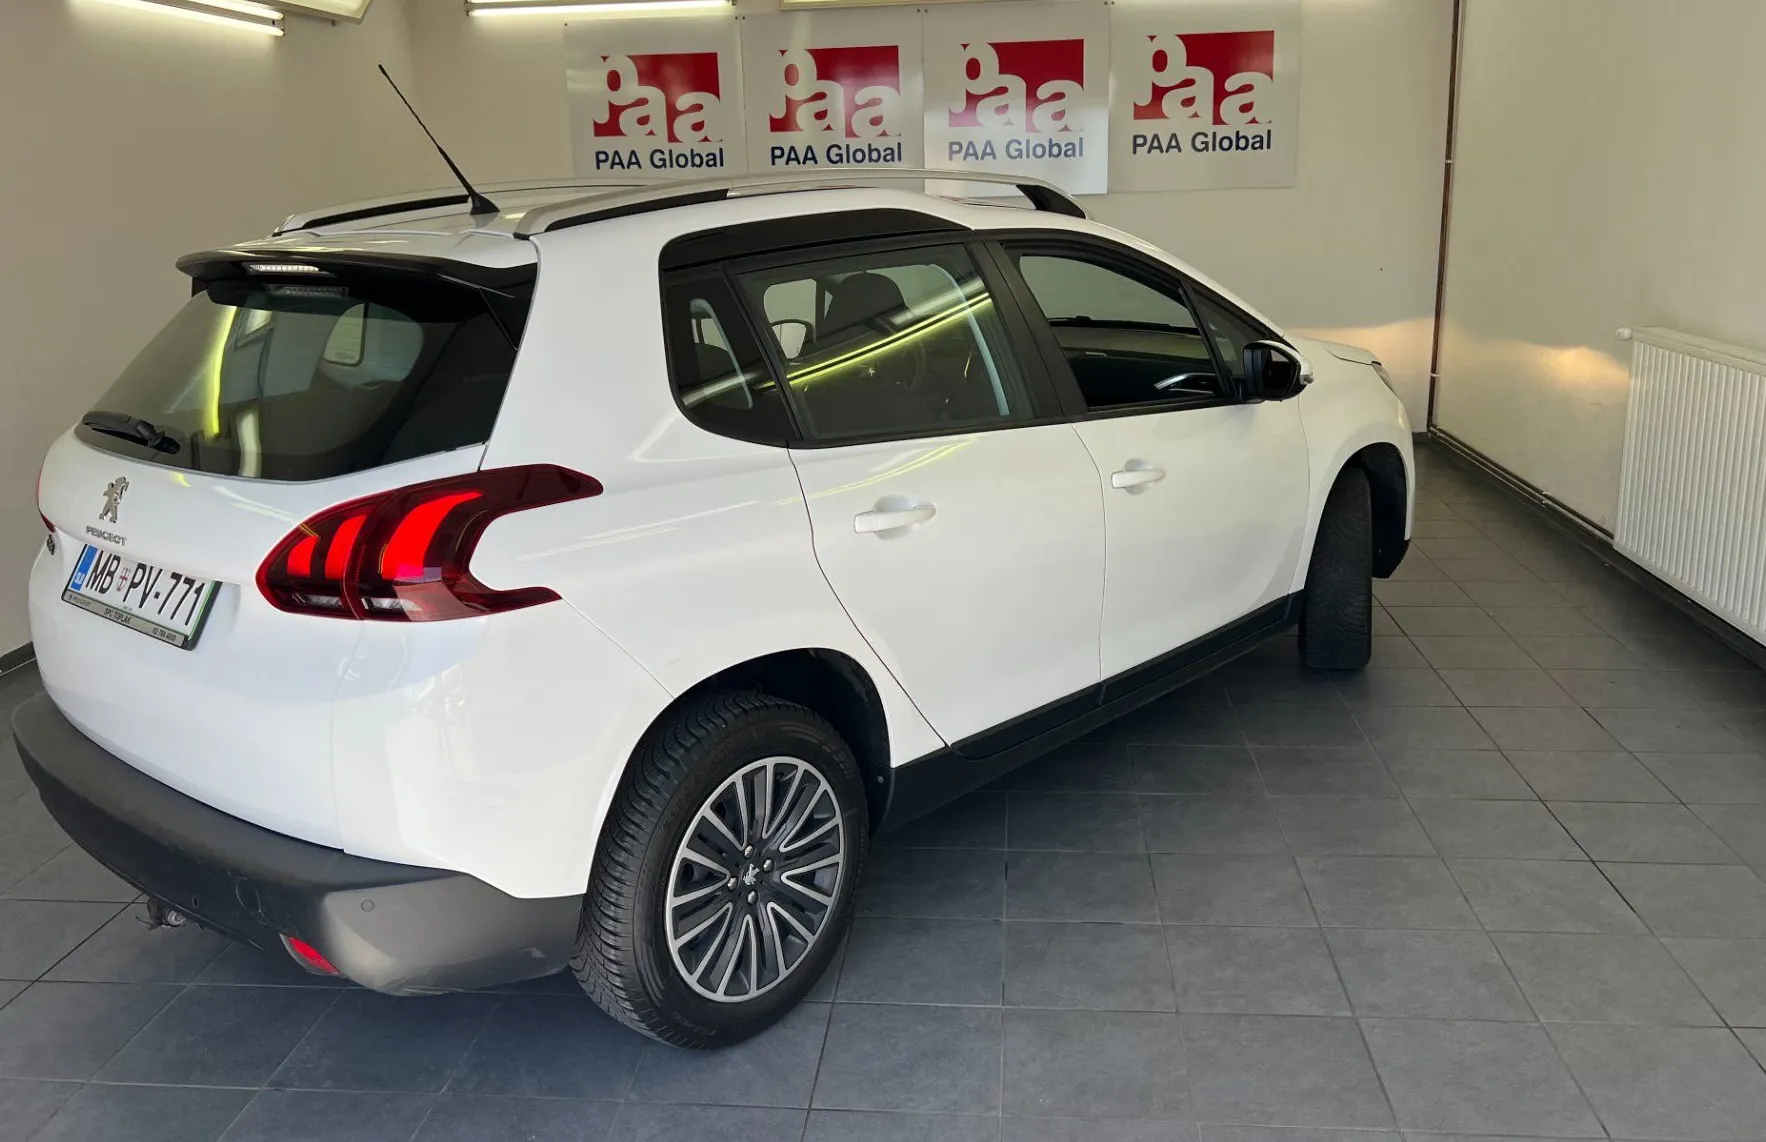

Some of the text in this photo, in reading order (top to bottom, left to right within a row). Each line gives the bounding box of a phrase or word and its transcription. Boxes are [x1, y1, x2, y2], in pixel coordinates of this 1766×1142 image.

[948, 137, 1084, 161] PAA Global
[1132, 129, 1272, 154] PAA Global
[595, 147, 724, 170] PAA Global
[770, 142, 902, 166] PAA Global
[85, 549, 206, 626] MB PV-771
